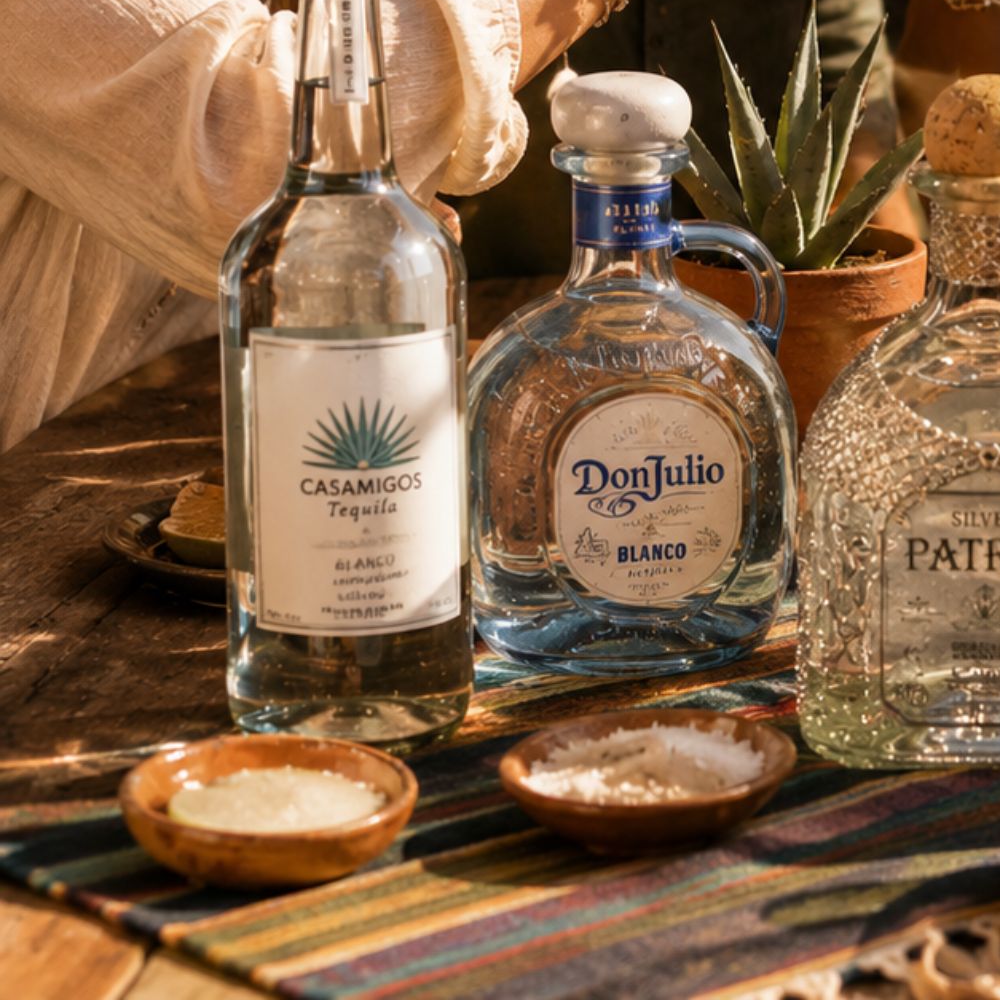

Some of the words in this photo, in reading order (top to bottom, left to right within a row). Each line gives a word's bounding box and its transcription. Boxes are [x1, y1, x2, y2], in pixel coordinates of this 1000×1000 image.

[300, 472, 422, 497] CASAMIGOS
[327, 498, 398, 522] Tequila
[617, 542, 687, 564] BLANCO
